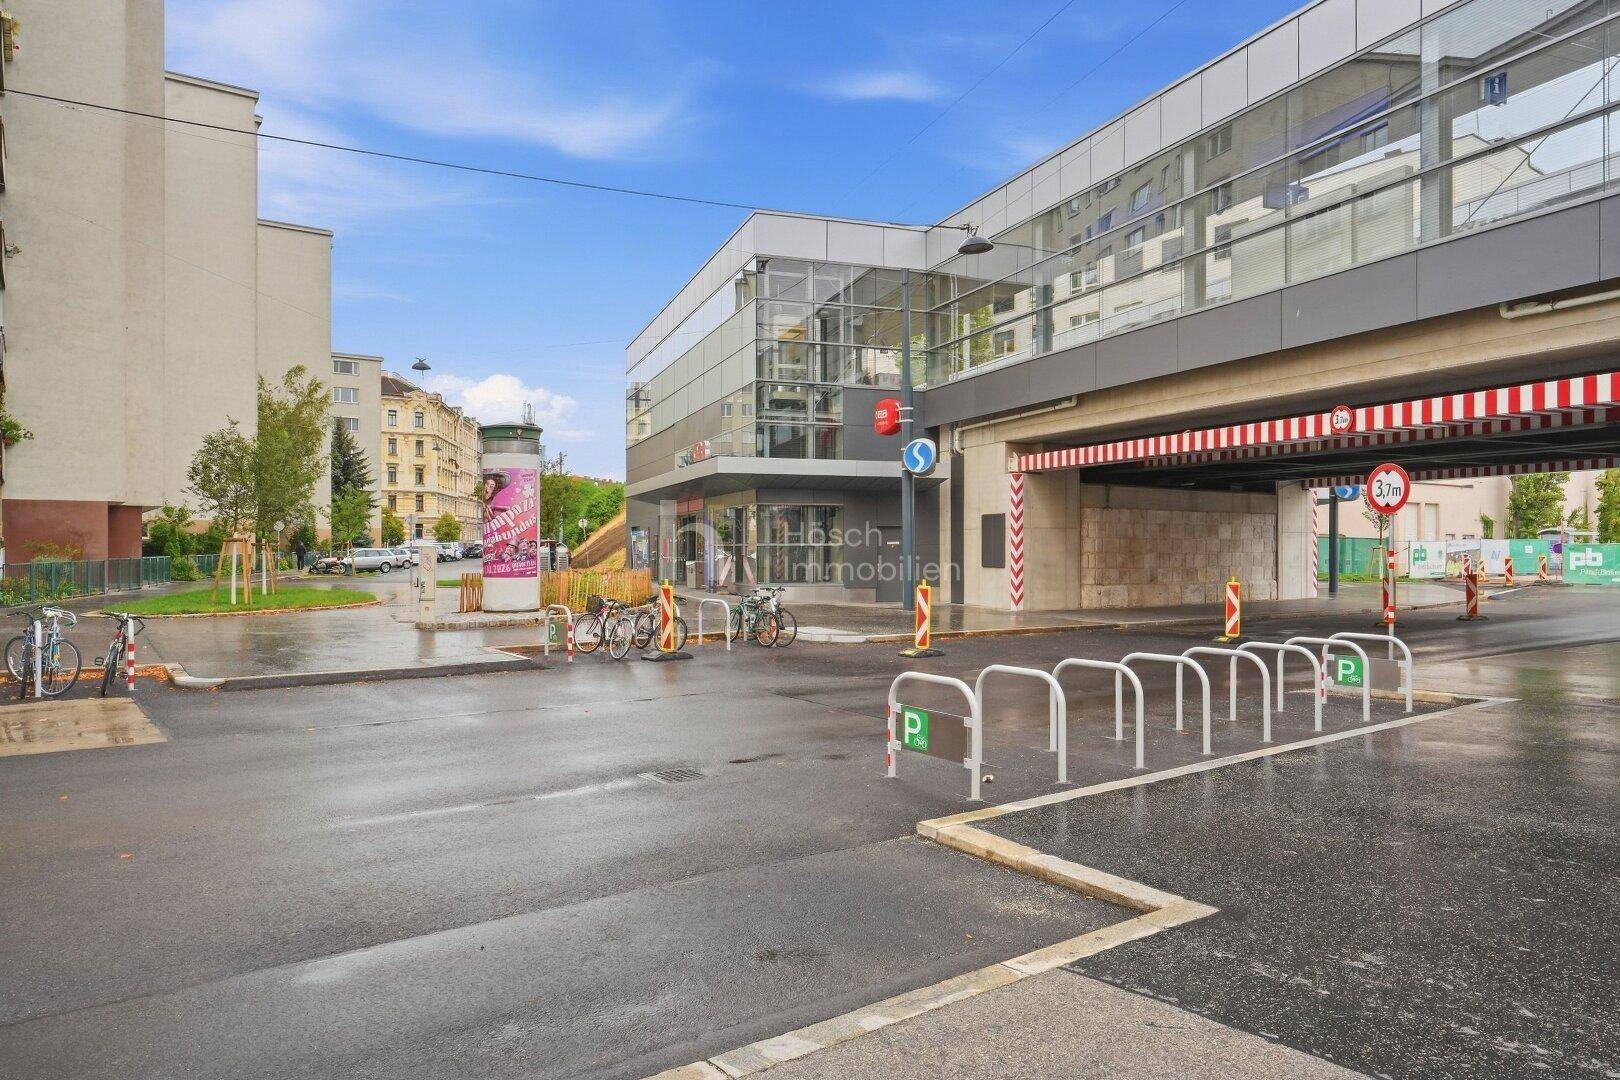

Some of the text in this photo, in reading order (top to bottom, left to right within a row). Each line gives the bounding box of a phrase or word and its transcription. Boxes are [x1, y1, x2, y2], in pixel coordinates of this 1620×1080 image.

[1375, 479, 1402, 499] 3,7m
[1337, 660, 1349, 681] P
[904, 711, 922, 745] P
